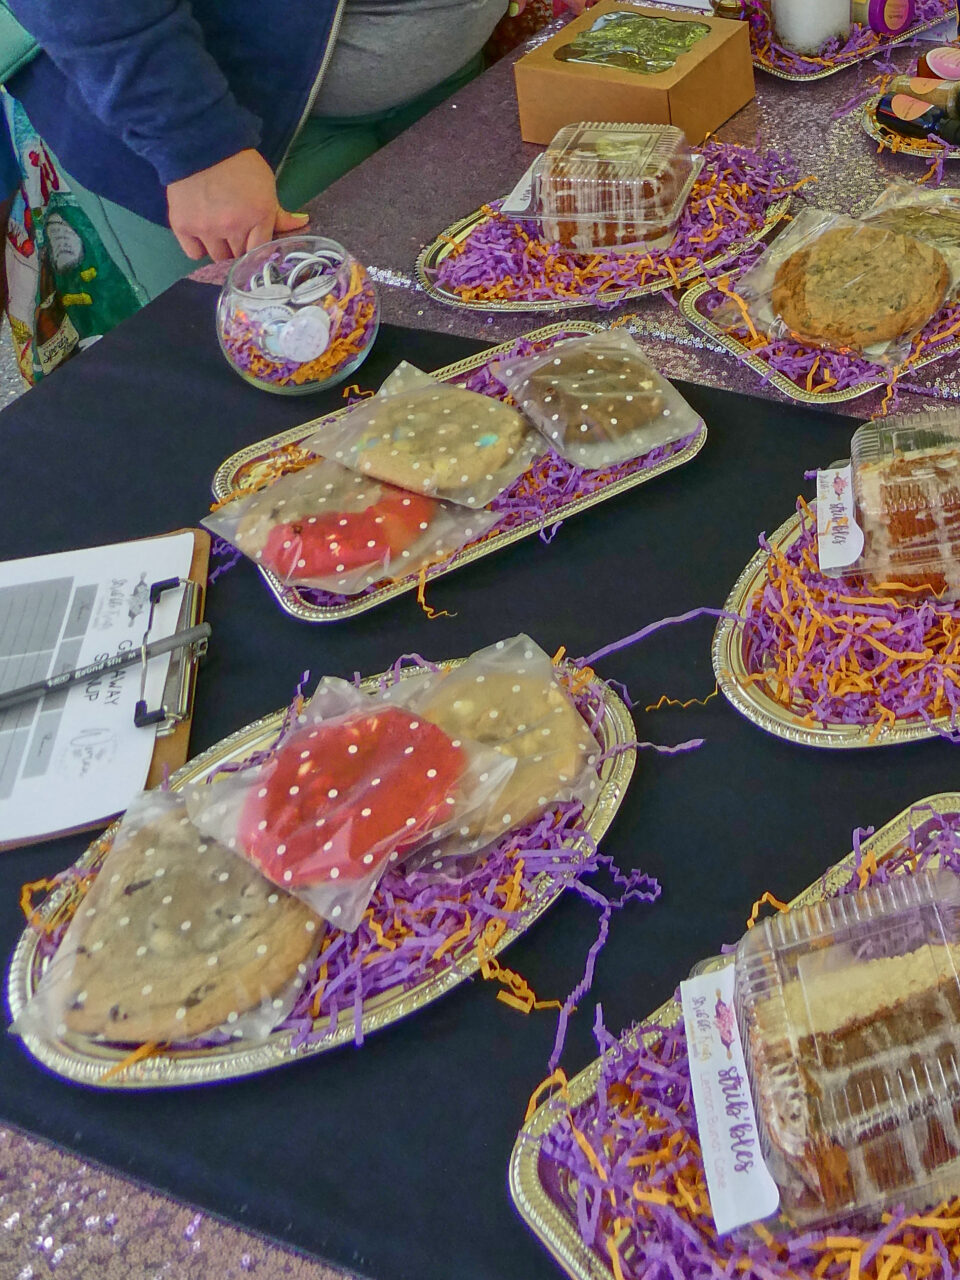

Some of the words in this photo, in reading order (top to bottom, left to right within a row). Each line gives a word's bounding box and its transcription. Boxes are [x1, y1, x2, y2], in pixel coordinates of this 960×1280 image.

[104, 639, 134, 706] GAWAY
[700, 1072, 714, 1112] Lemon
[717, 1065, 755, 1174] strib'bles
